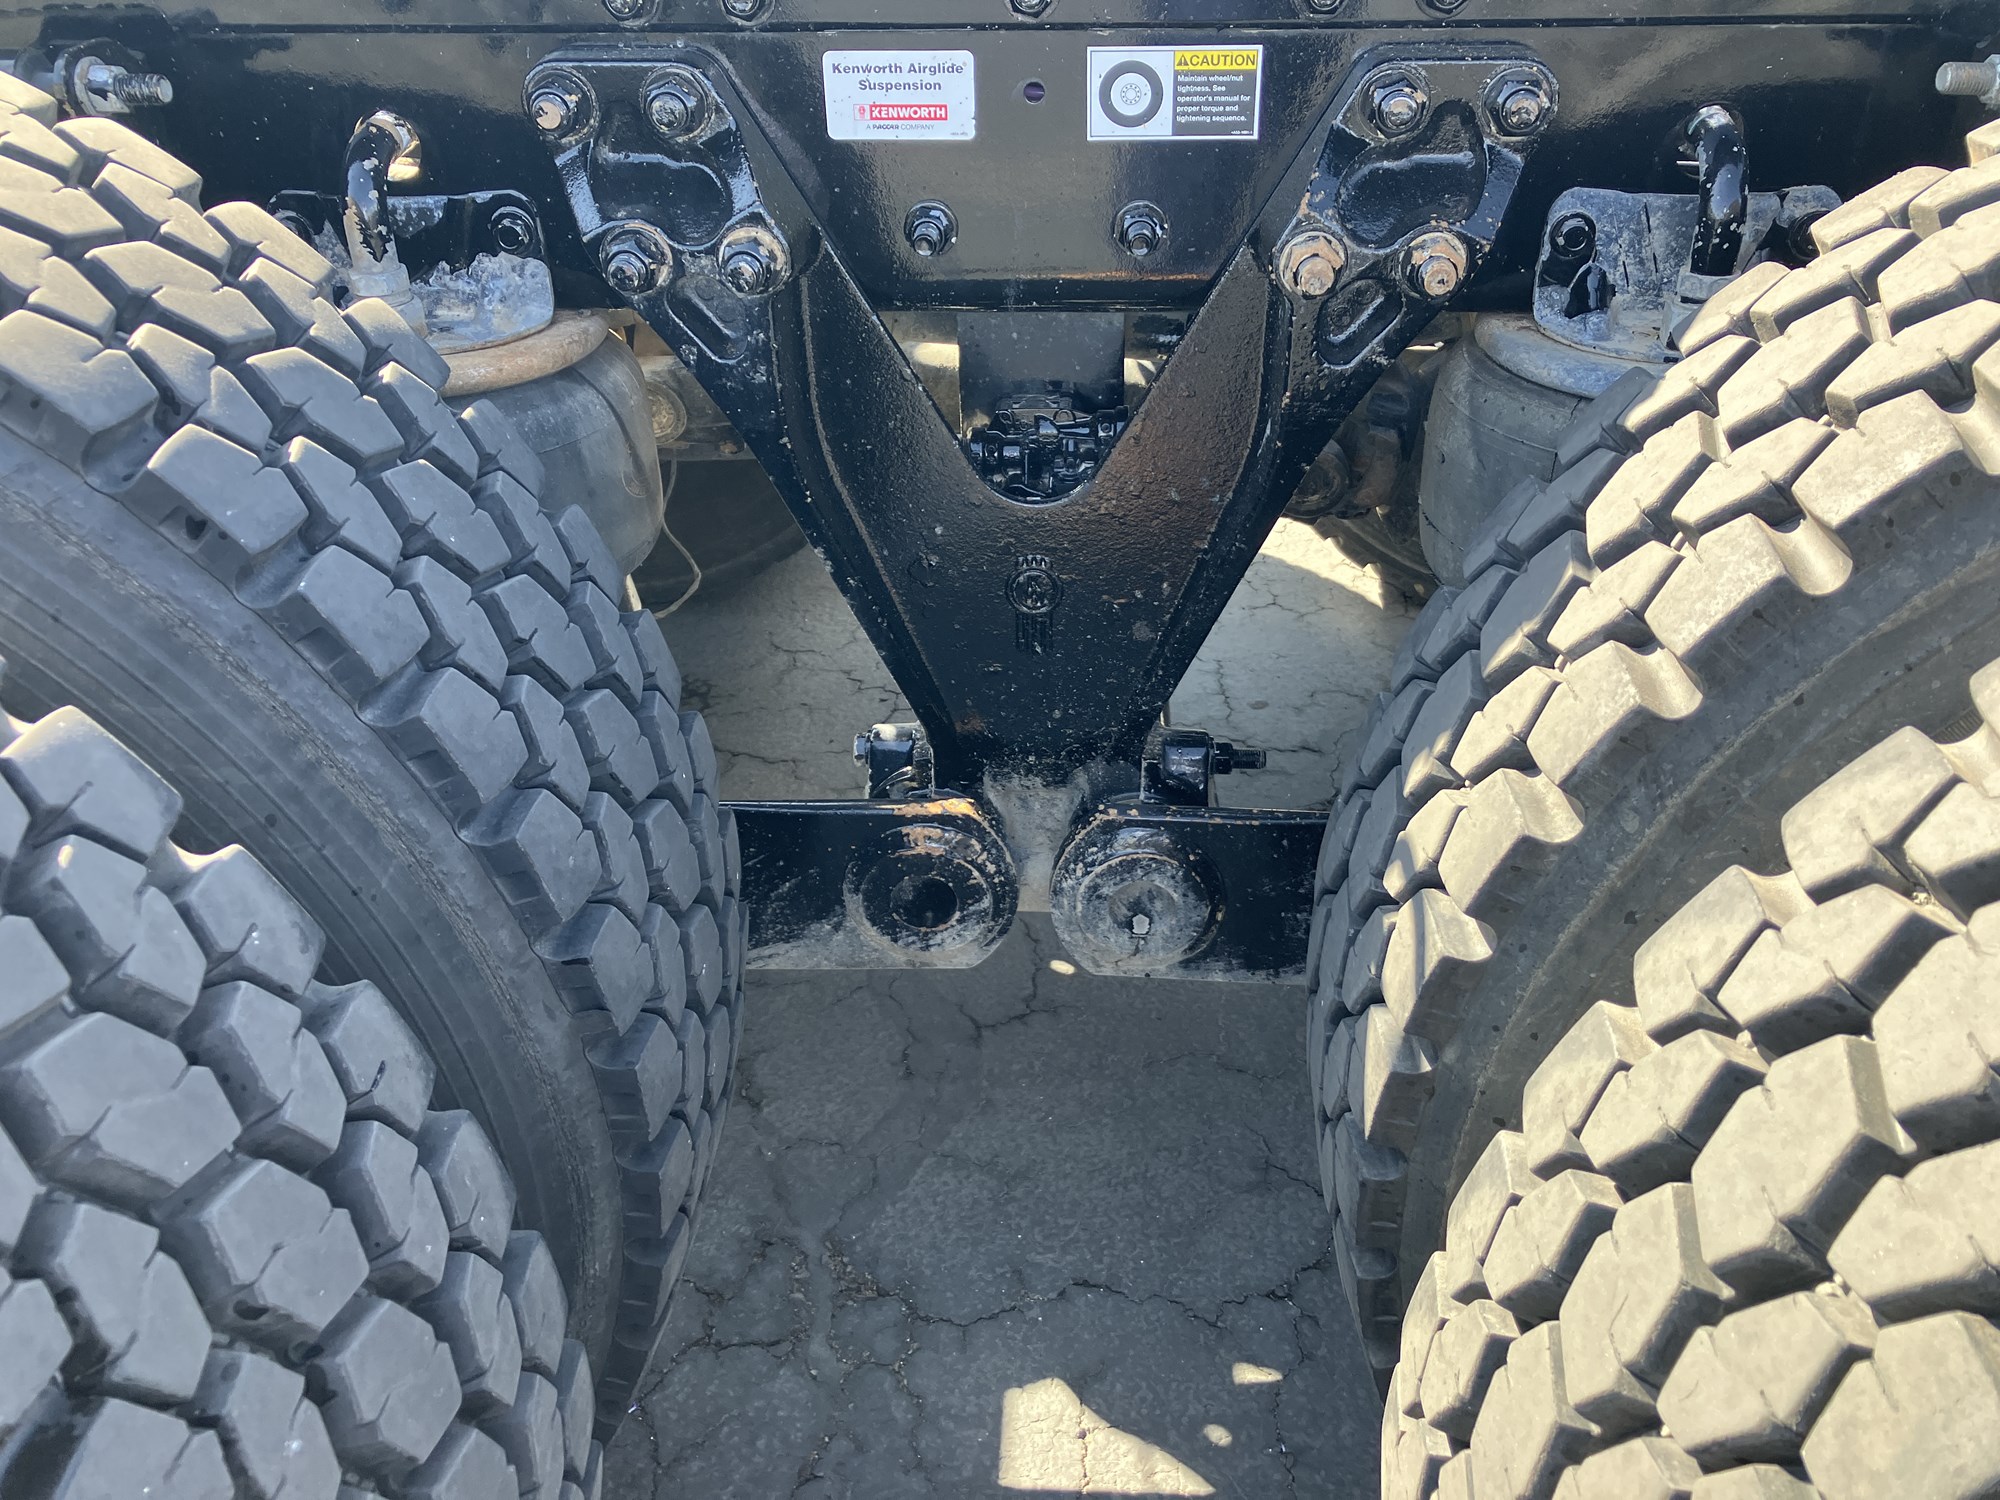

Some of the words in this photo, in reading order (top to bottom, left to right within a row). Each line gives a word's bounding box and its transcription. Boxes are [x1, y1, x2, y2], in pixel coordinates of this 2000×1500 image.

[1190, 54, 1255, 66] CAUTION
[832, 63, 902, 73] Kenworth
[859, 79, 941, 92] Suspension
[872, 107, 946, 118] KENWORTH
